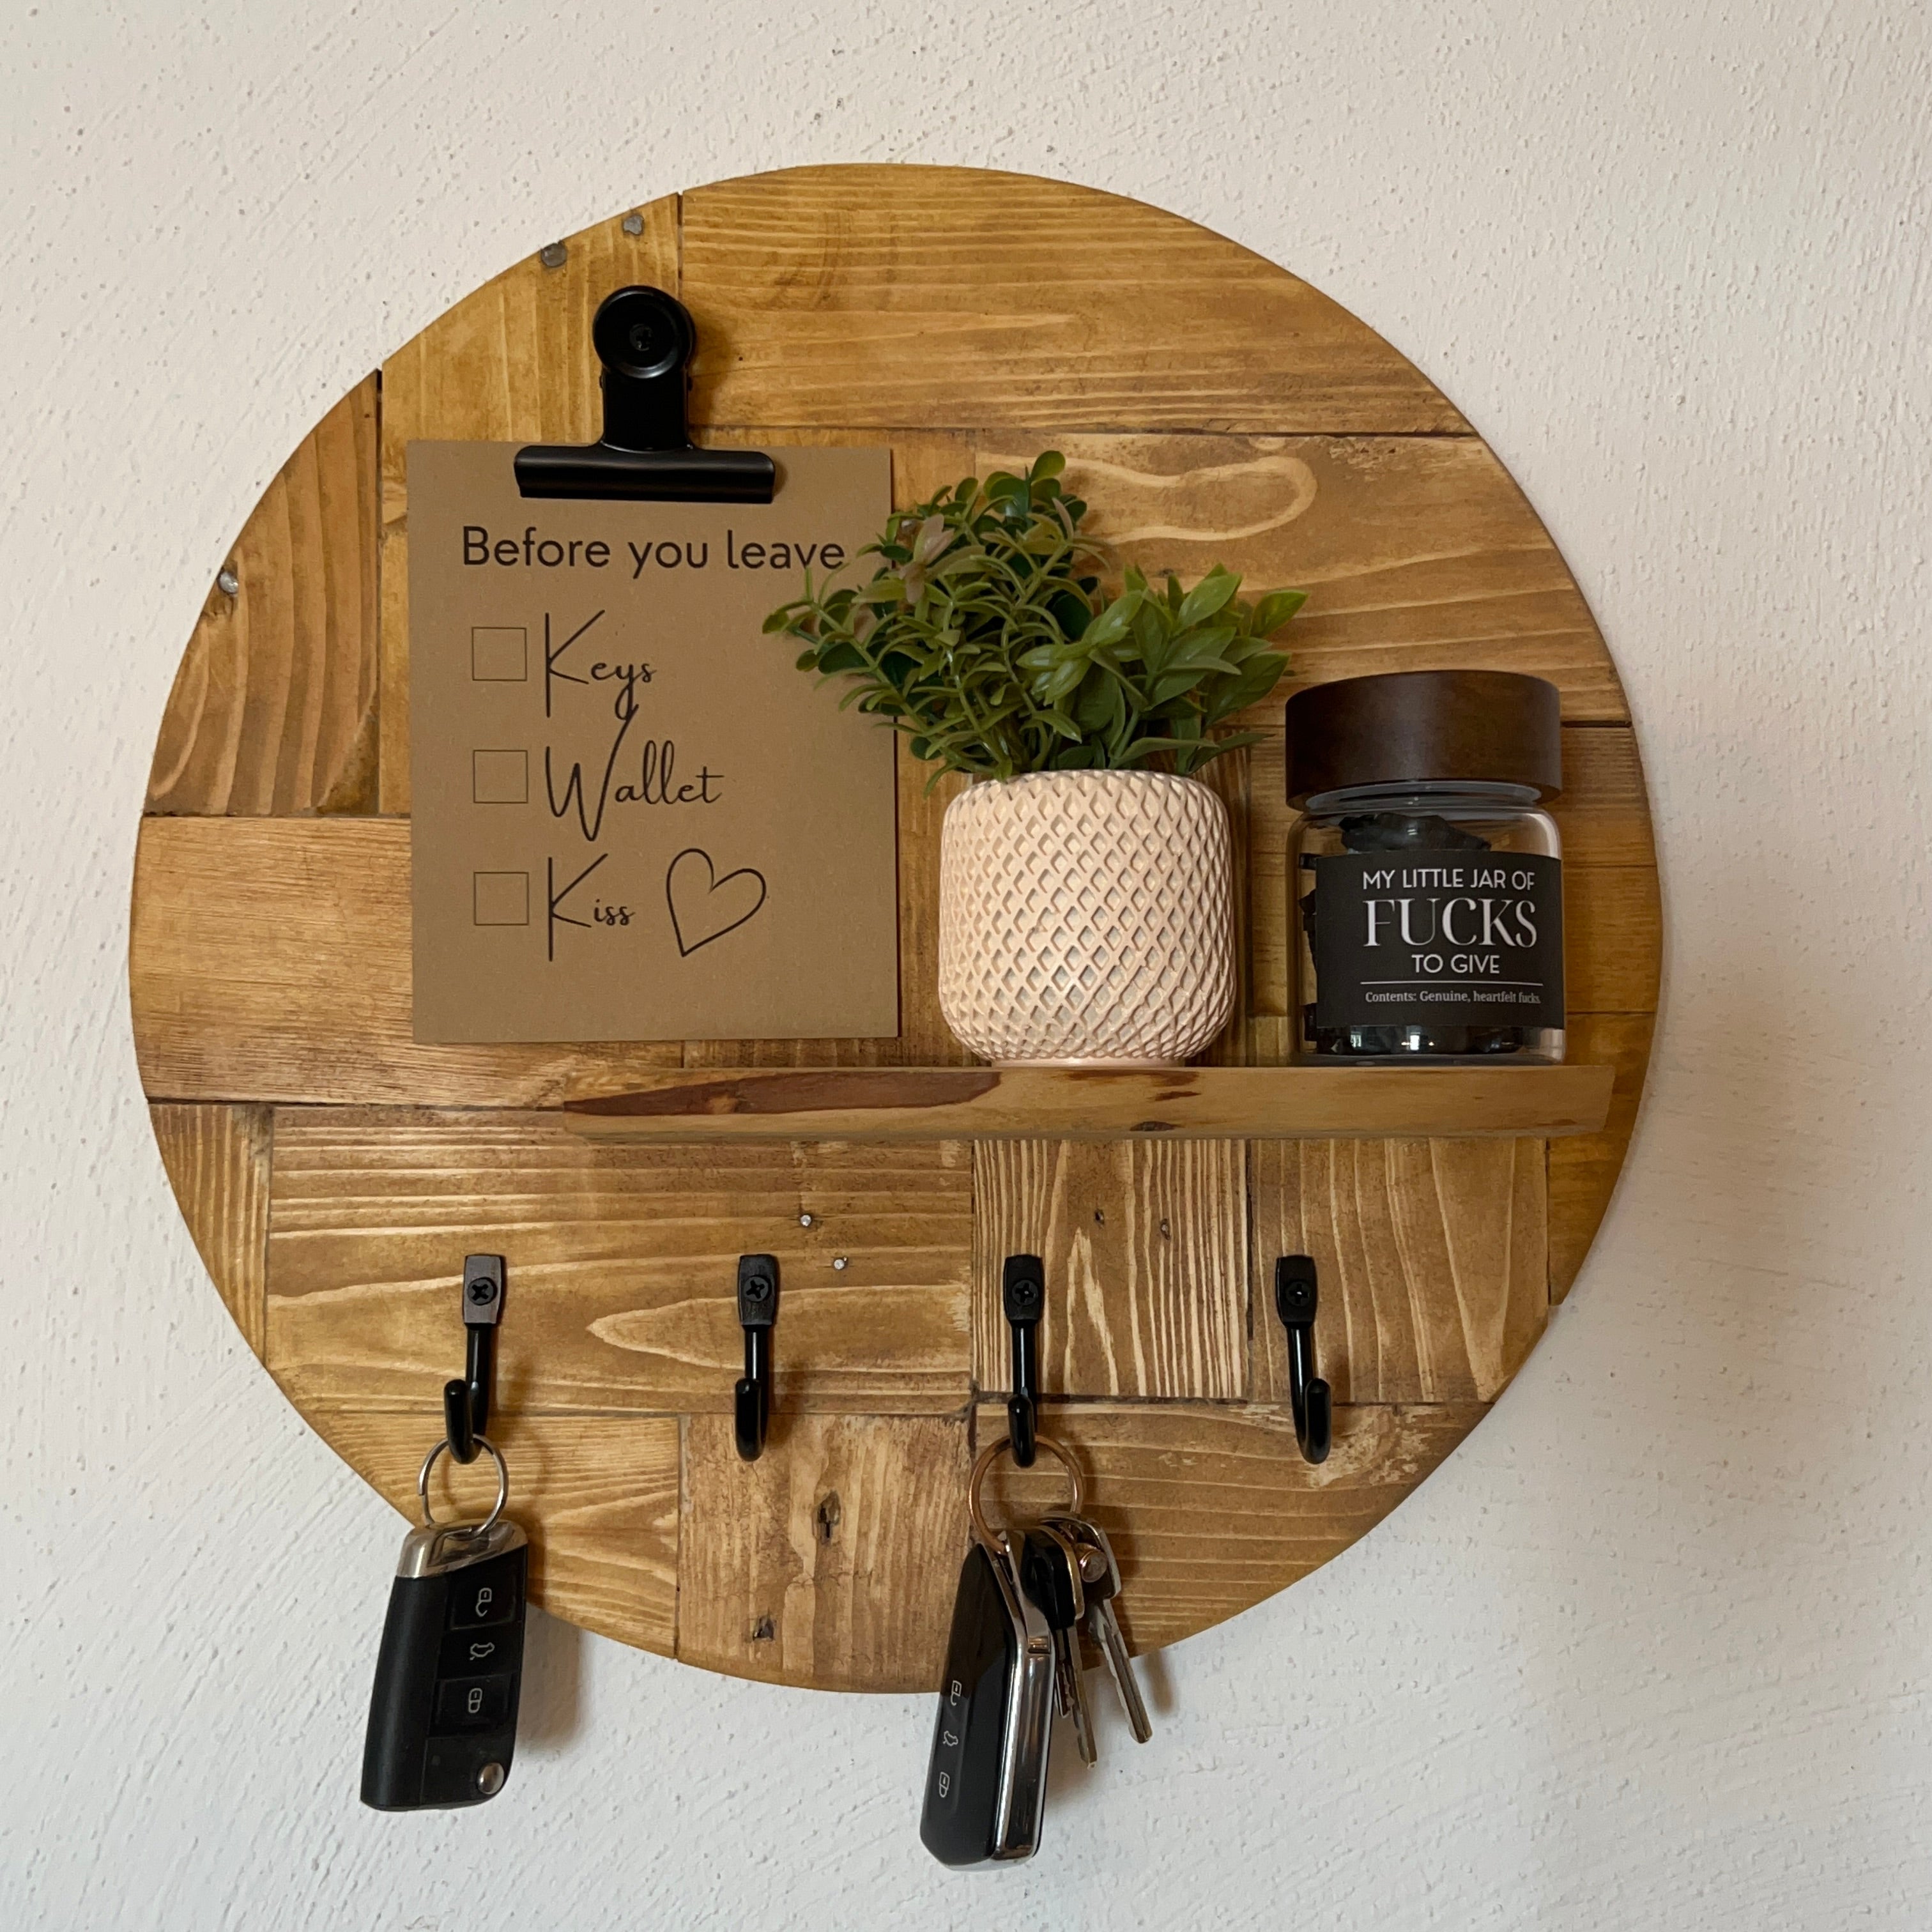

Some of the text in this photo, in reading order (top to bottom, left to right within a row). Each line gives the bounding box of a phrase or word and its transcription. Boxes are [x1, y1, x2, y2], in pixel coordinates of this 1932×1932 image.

[462, 526, 845, 579] Before you leave
[544, 610, 658, 719] Keys
[545, 703, 726, 842] Wallet
[1362, 868, 1536, 890] MY LITTLE JAR OF
[548, 853, 636, 962] Kiss
[1361, 896, 1538, 948] FUCKS
[1411, 953, 1501, 974] TO GIVE
[1365, 991, 1418, 1002] Contents:
[1419, 990, 1471, 1003] Genuine,
[1473, 990, 1517, 1003] heartfelt
